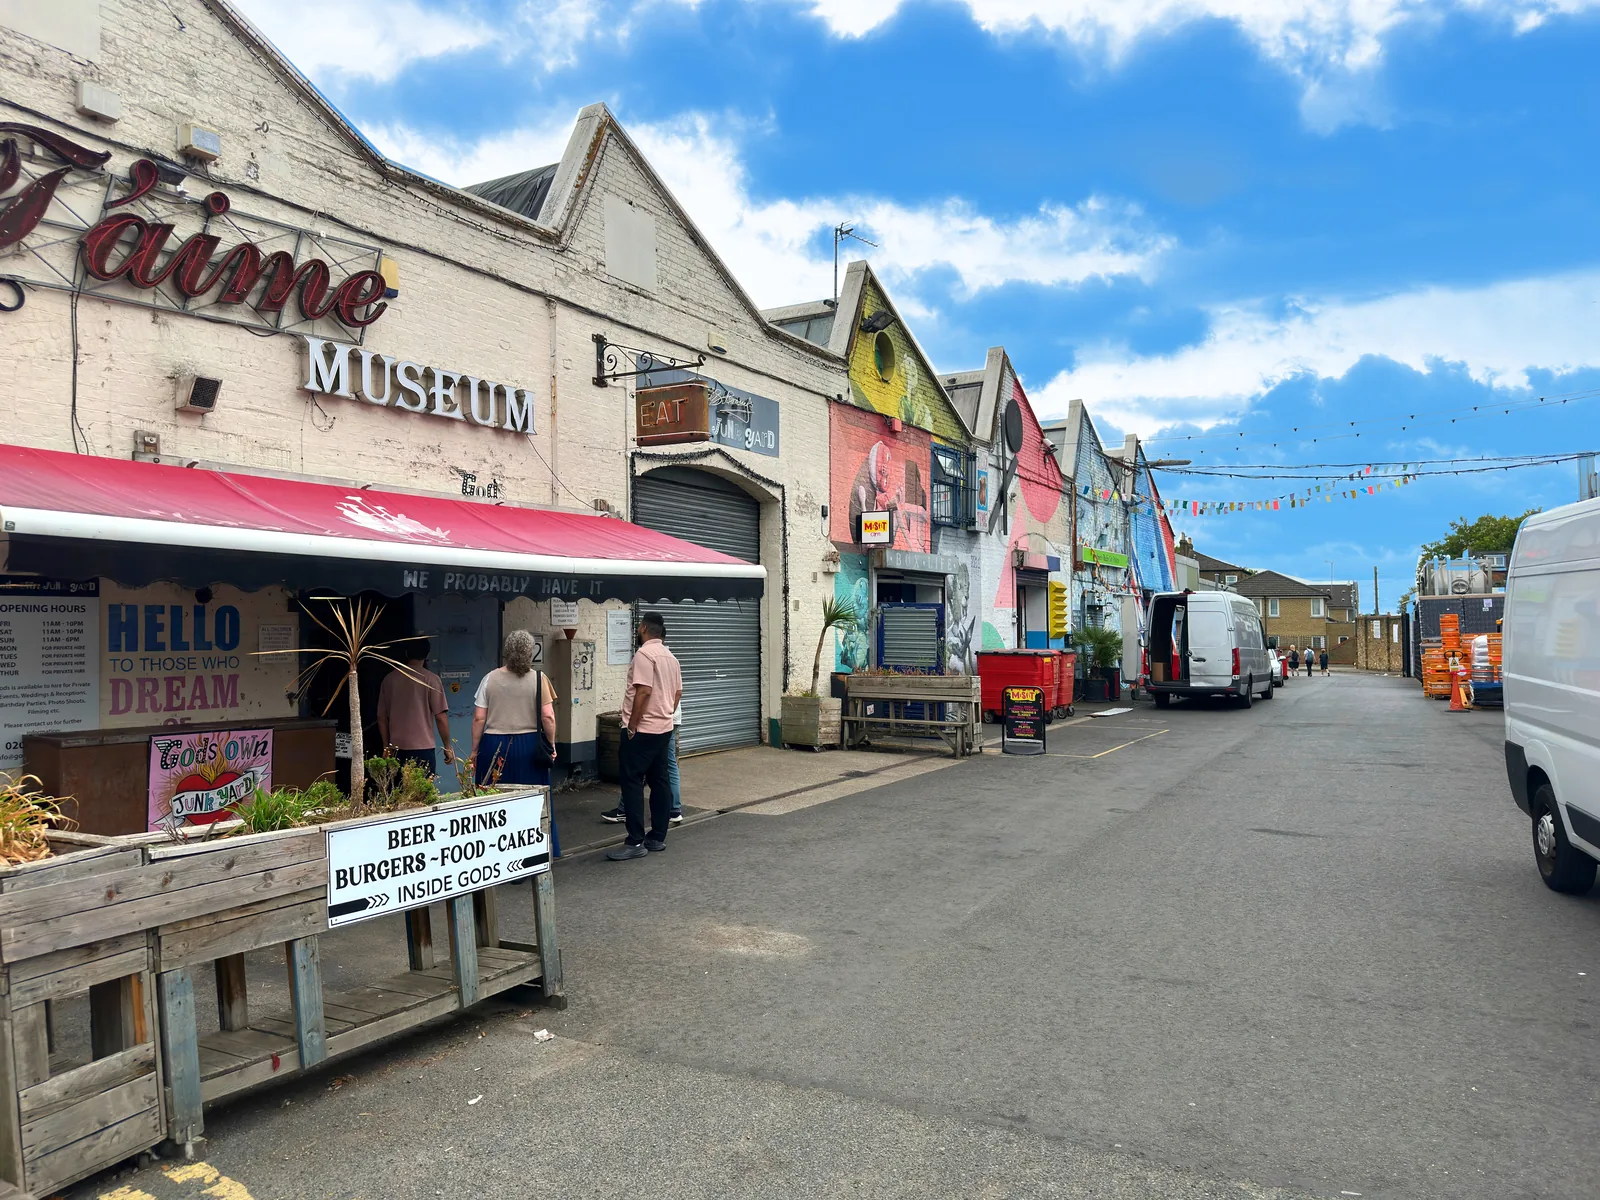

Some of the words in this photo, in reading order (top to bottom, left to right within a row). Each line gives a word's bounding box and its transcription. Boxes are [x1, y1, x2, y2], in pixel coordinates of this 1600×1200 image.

[302, 336, 537, 435] MUSEUM
[640, 398, 687, 427] EAT
[896, 553, 920, 569] BOX
[928, 557, 952, 571] LIFE
[403, 570, 430, 589] WE
[443, 573, 530, 593] PROBABLY
[542, 578, 578, 595] HAVE
[589, 580, 604, 595] IT
[0, 604, 48, 613] OPENING
[51, 604, 86, 613] HOURS
[108, 604, 240, 652] HELLO
[109, 658, 134, 672] TO
[139, 657, 197, 671] THOSE
[202, 656, 240, 669] WHO
[108, 673, 240, 715] DREAM
[387, 823, 435, 850] BEER
[335, 852, 426, 890] BURGERS
[398, 875, 452, 903] INSIDE
[458, 862, 501, 888] GODS
